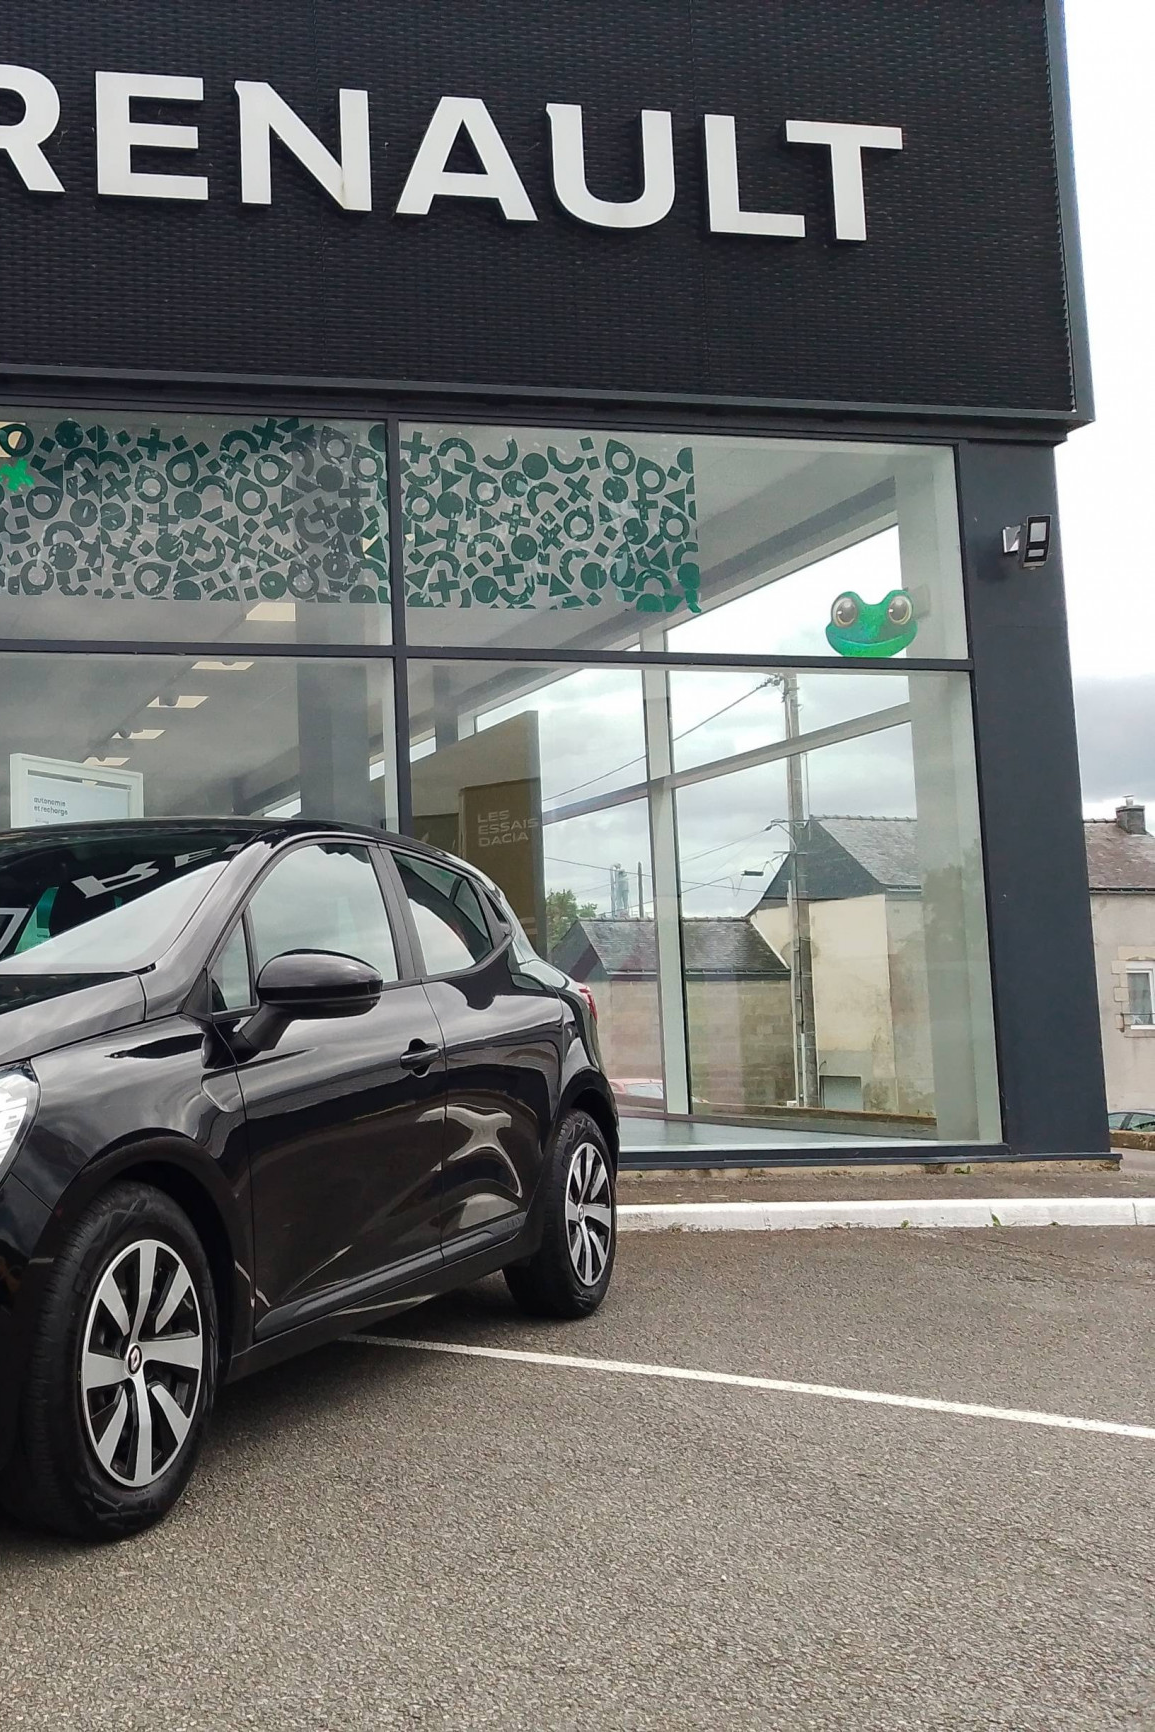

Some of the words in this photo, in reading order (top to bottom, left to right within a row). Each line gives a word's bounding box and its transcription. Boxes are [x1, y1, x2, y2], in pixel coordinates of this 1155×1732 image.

[33, 796, 66, 807] autonomie
[40, 805, 69, 816] recharge
[477, 809, 510, 823] LES
[477, 817, 539, 835] ESSAIS
[478, 831, 529, 847] DACIA
